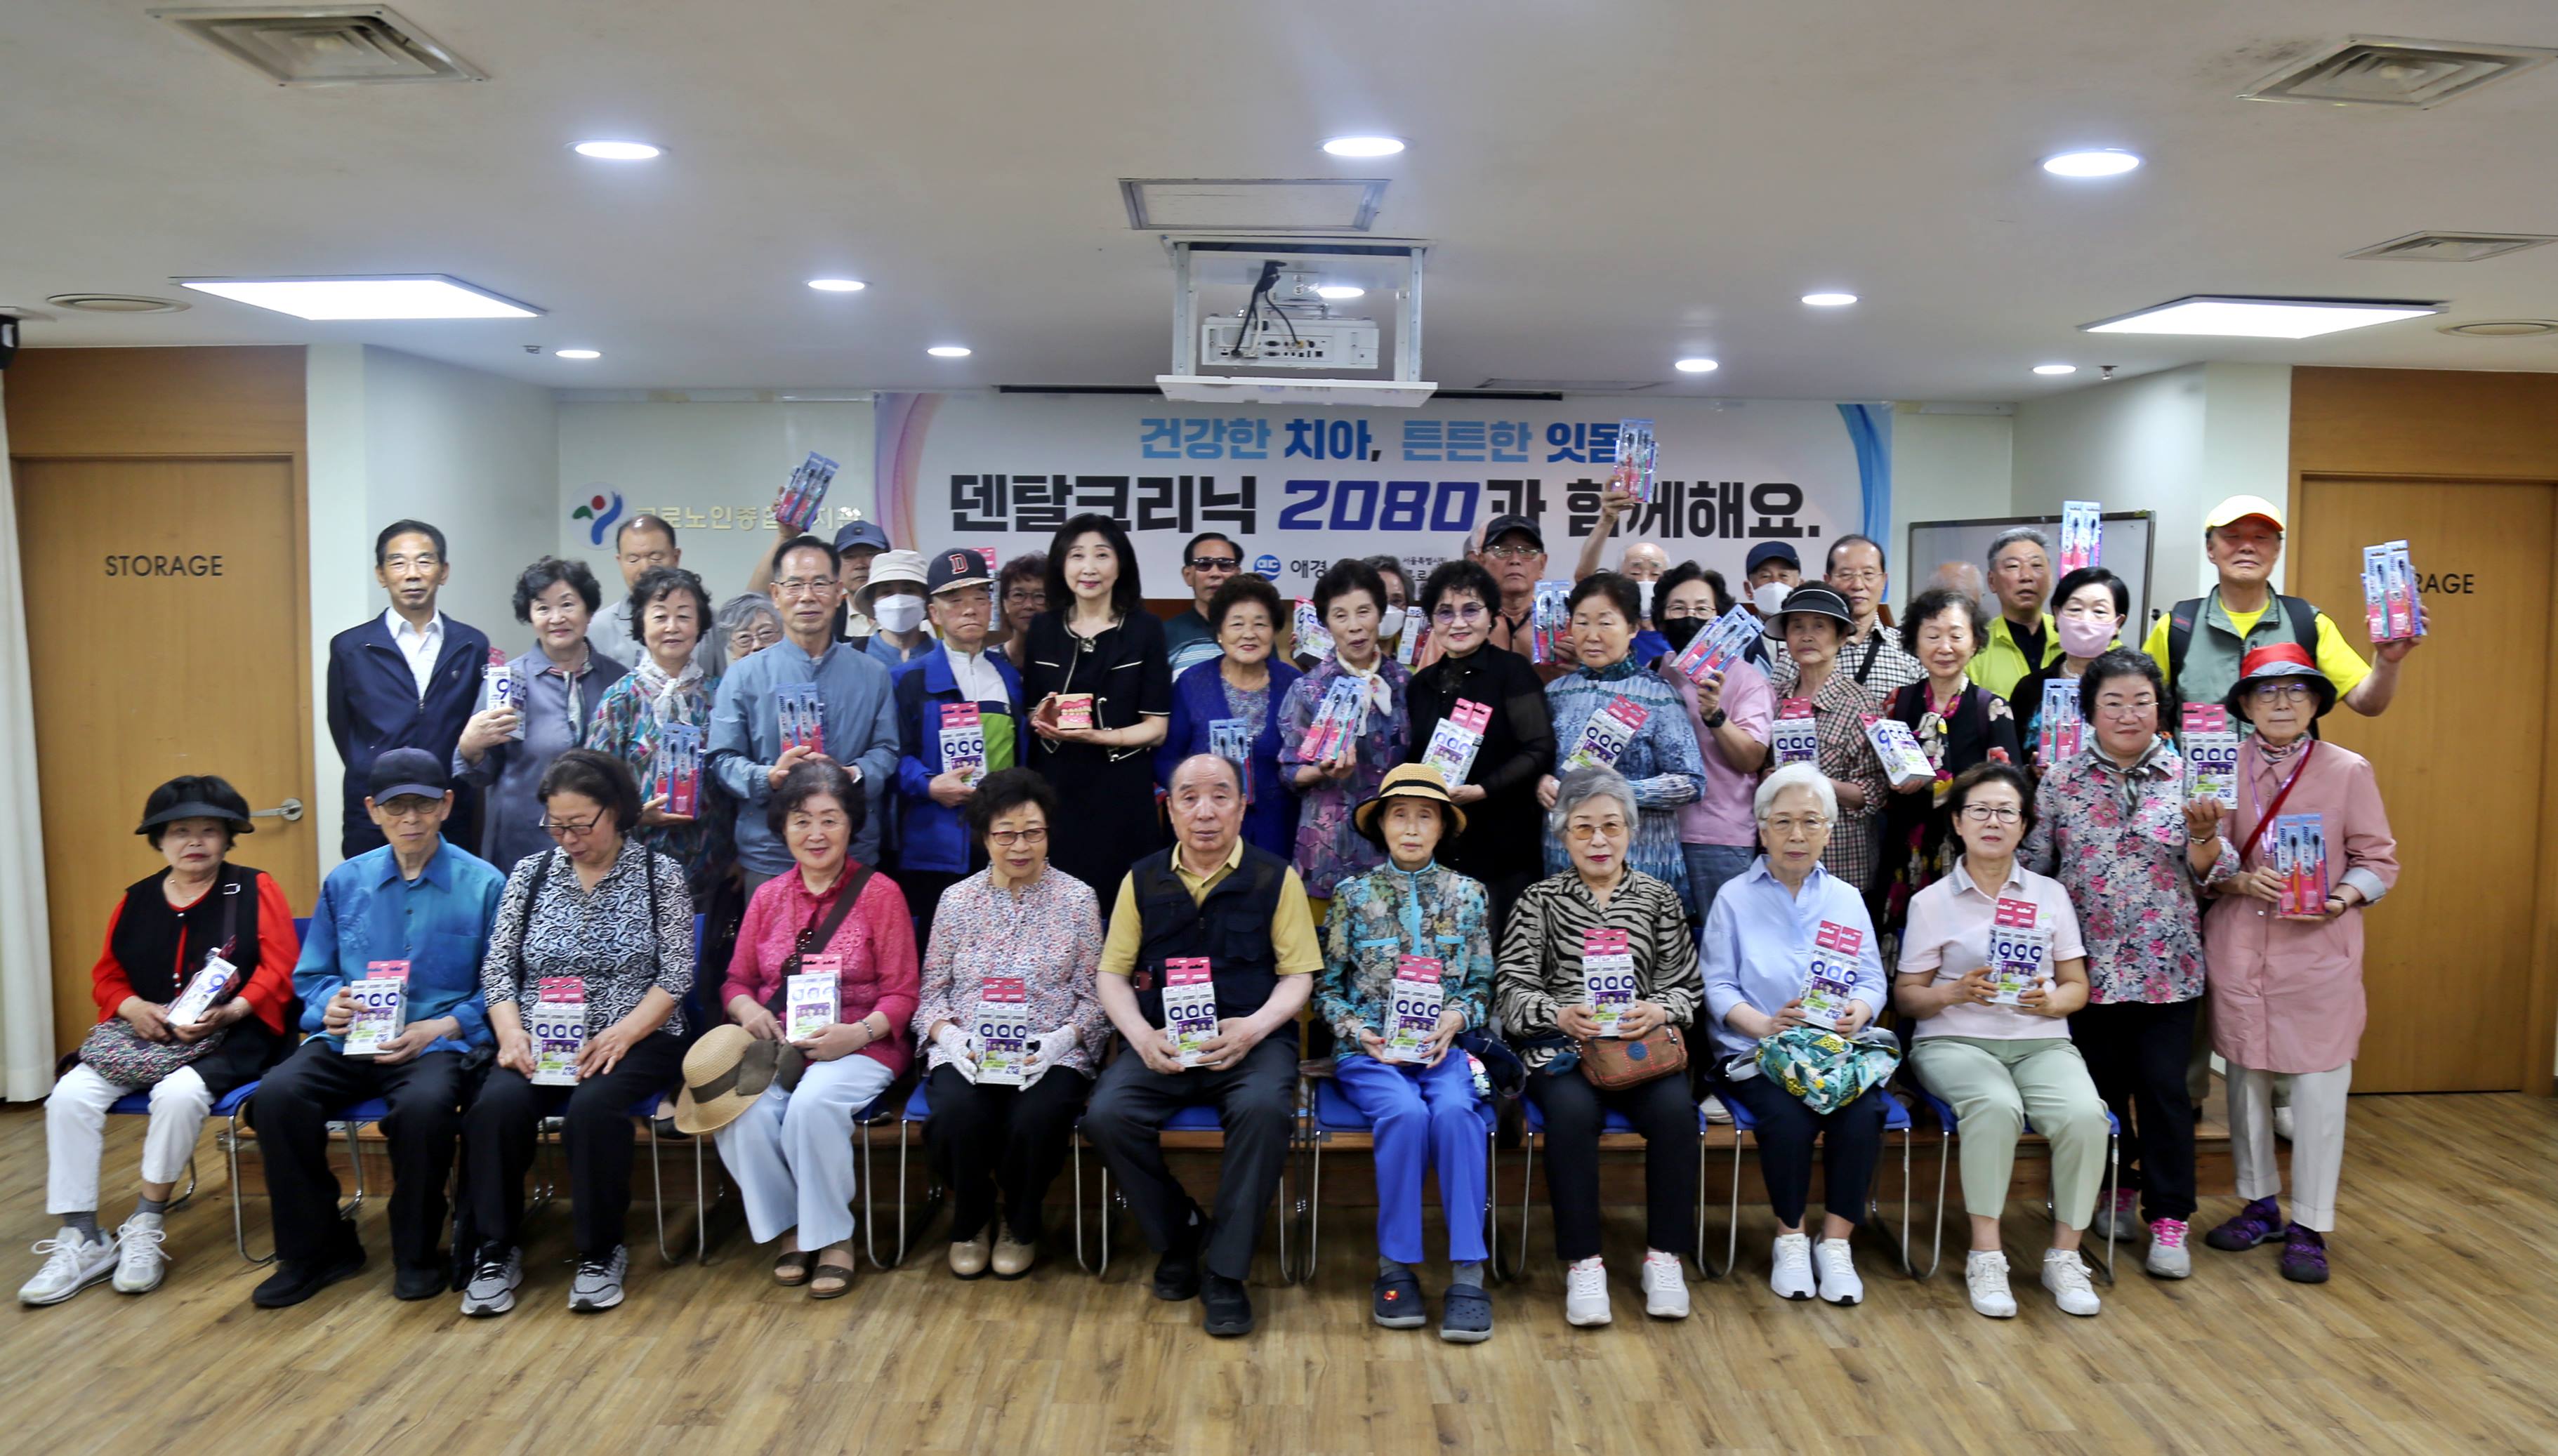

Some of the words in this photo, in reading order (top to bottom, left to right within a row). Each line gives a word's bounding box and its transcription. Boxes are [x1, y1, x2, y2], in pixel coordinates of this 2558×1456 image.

[1141, 418, 1272, 459] 건강한
[1284, 419, 1381, 462] 치아,
[1402, 421, 1533, 463] 튼튼한
[1546, 423, 1620, 463] 잇몸
[951, 475, 1256, 534] 덴탈크리닉
[105, 555, 223, 576] STORAGE
[949, 554, 968, 574] D
[2415, 573, 2474, 594] RAGE
